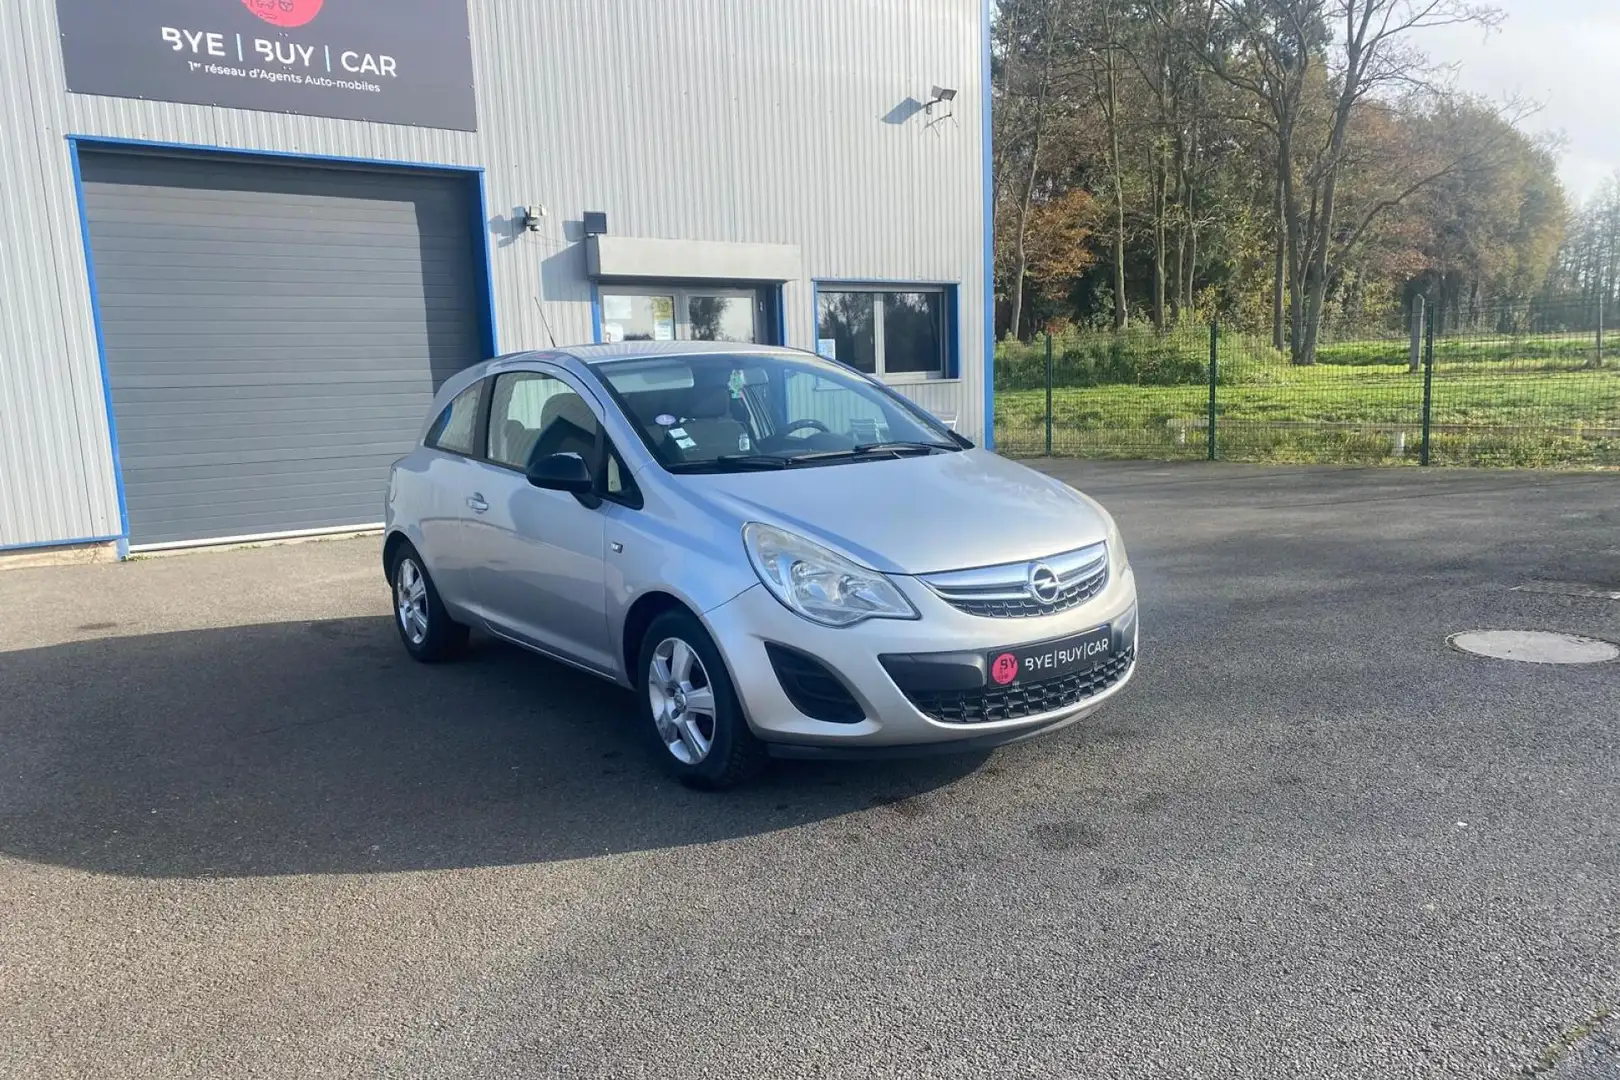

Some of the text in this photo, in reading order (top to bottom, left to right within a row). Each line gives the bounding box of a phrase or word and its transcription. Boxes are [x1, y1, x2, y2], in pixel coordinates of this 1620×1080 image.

[161, 26, 398, 78] BYE BUY CAR
[204, 63, 246, 77] réseau
[249, 67, 302, 83] d'Agents
[304, 75, 381, 92] Auto-mobiles
